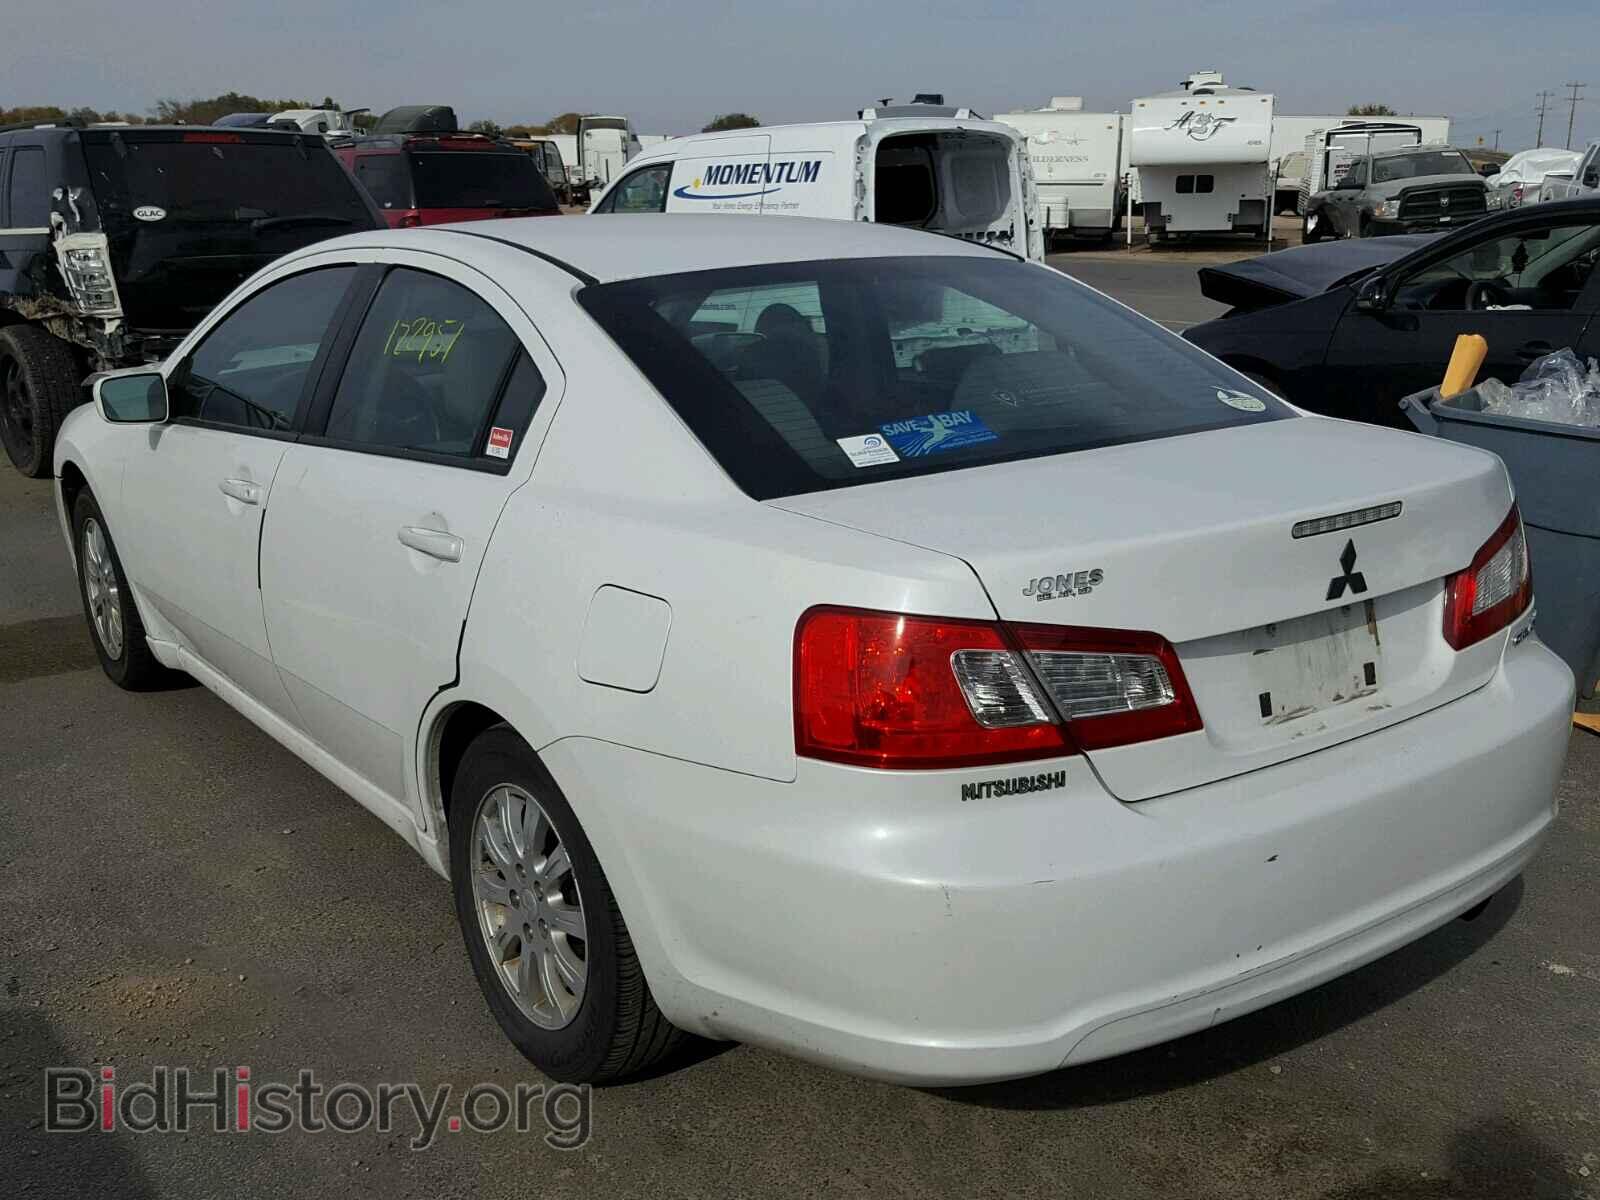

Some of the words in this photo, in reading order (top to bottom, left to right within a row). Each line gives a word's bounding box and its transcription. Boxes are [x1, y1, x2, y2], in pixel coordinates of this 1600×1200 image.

[1029, 154, 1089, 163] ILDERNESS
[702, 160, 822, 185] MOMENTUM
[882, 419, 921, 437] SAVE
[939, 410, 974, 428] BAY
[1022, 568, 1104, 597] JONES
[961, 770, 1066, 801] MITSUBISHI
